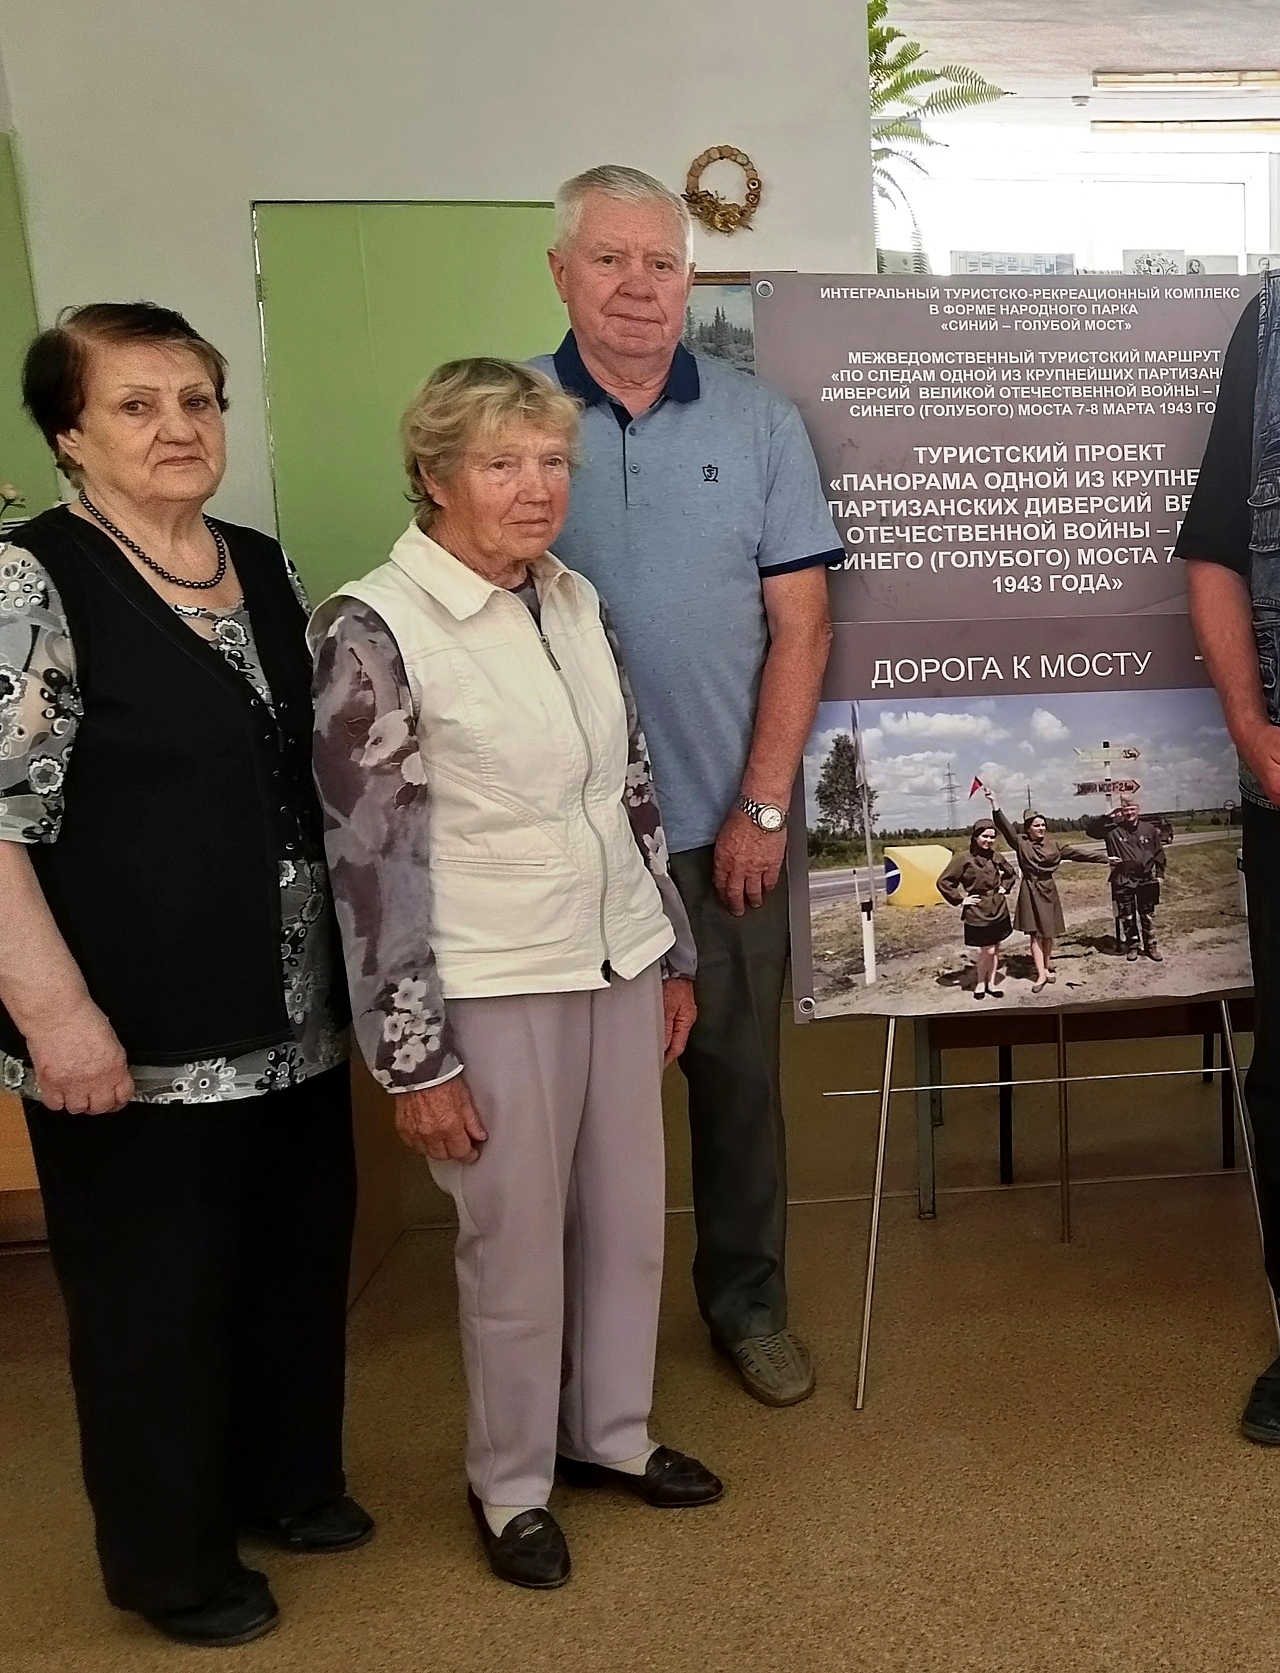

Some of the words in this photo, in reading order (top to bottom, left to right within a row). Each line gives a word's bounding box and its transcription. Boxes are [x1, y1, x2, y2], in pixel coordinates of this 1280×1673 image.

[820, 285, 940, 300] ИНТЕГРАЛЬНЫЙ
[943, 285, 1160, 302] ТУРИСТСКО-РЕКРЕАЦИОННЫЙ
[1164, 287, 1240, 299] КОМПЛЕКС
[929, 303, 940, 315] В
[942, 304, 997, 316] ФОРМЕ
[999, 303, 1088, 317] НАРОДНОГО
[1091, 303, 1139, 315] ПАРКА
[940, 317, 999, 331] «СИНИЙ
[1014, 317, 1081, 331] ГОЛУБОЙ
[1084, 319, 1132, 331] МОСТ»
[848, 349, 1035, 367] МЕЖВЕДОМСТВЕННЫЙ
[1037, 348, 1141, 364] ТУРИСТСКИЙ
[1144, 350, 1222, 363] МАРШРУТ
[831, 369, 864, 382] «ПО
[867, 369, 936, 384] СЛЕДАМ
[939, 366, 997, 384] ОДНОЙ
[1001, 369, 1022, 382] ИЗ
[1025, 365, 1135, 381] КРУПНЕЙШИХ
[1137, 367, 1224, 380] ПАРТИЗАН
[820, 384, 911, 402] ДИВЕРСИЙ
[920, 384, 995, 399] ВЕЛИКОЙ
[999, 382, 1137, 399] ОТЕЧЕСТВЕННОЙ
[1140, 382, 1199, 398] ВОЙНЫ
[849, 404, 916, 418] СИНЕГО
[919, 403, 1014, 420] (ГОЛУБОГО)
[1018, 403, 1074, 416] МОСТА
[1075, 403, 1099, 416] 7-8
[1102, 402, 1156, 415] МАРТА
[1159, 402, 1193, 415] 1943
[913, 441, 1068, 464] ТУРИСТСКИЙ
[1074, 443, 1166, 462] ПРОЕКТ
[829, 472, 979, 492] «ПАНОРАМА
[984, 467, 1068, 493] ОДНОЙ
[1075, 470, 1105, 488] ИЗ
[828, 497, 1020, 518] ПАРТИЗАНСКИХ
[1024, 495, 1152, 519] ДИВЕРСИЙ
[846, 519, 1056, 544] ОТЕЧЕСТВЕННОЙ
[1063, 518, 1150, 540] ВОЙНЫ
[930, 548, 1071, 573] (ГОЛУБОГО)
[1077, 547, 1158, 566] МОСТА
[992, 575, 1043, 593] 1943
[1049, 573, 1123, 595] ГОДА»
[871, 656, 1004, 689] ДОРОГА
[1013, 655, 1031, 679] К
[1040, 651, 1152, 678] МОСТУ
